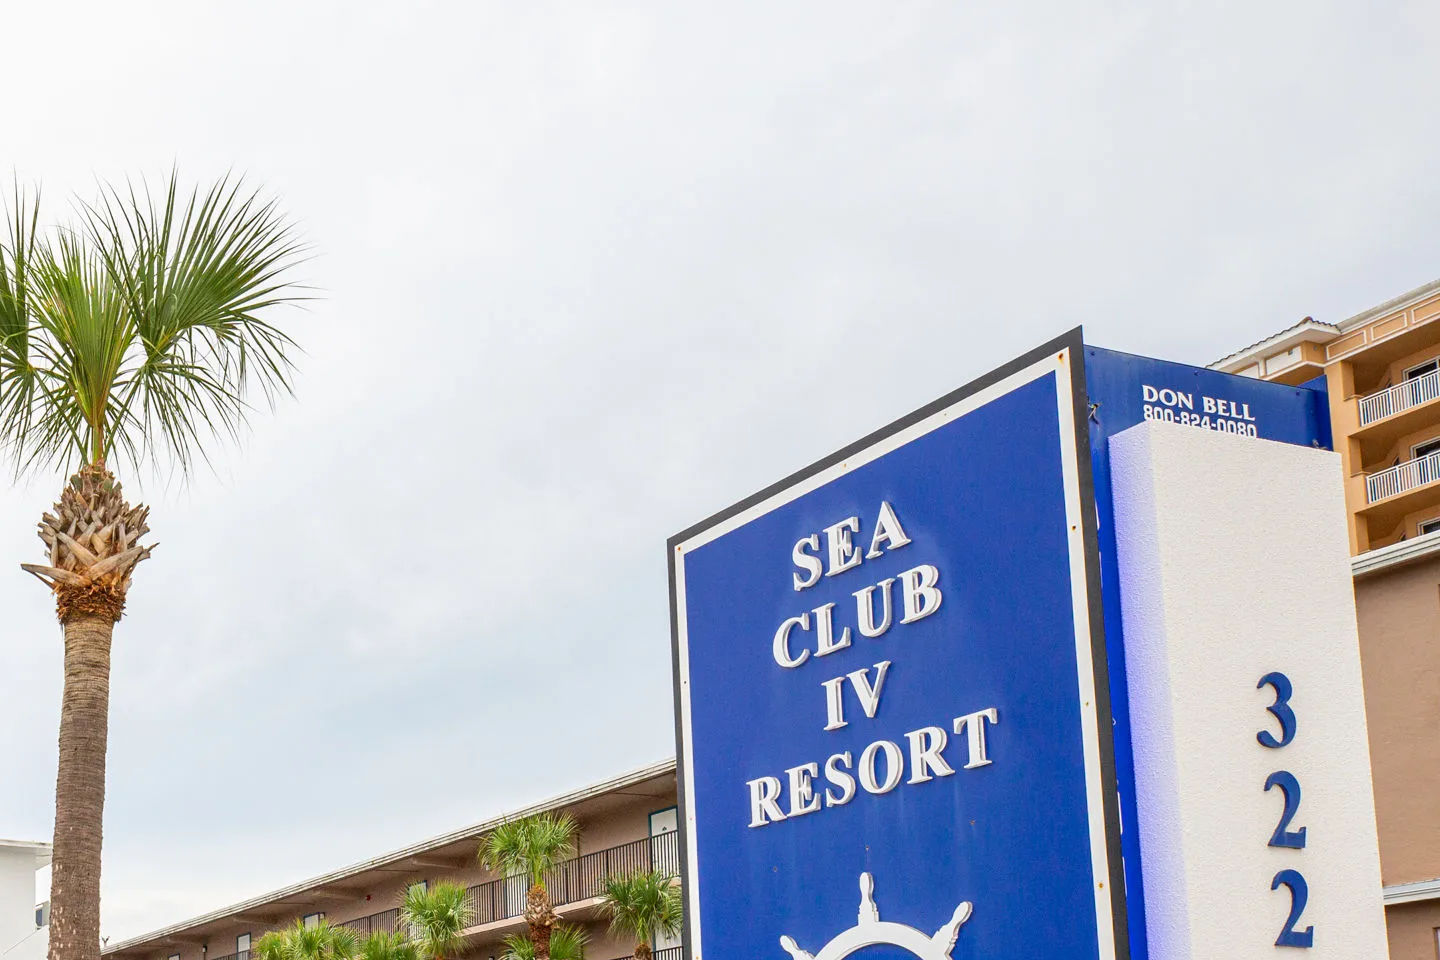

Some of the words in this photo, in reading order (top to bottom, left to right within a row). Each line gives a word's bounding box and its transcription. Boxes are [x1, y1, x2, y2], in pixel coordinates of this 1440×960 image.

[1142, 384, 1194, 410] DON
[1202, 396, 1256, 421] BELL
[1143, 404, 1258, 438] 800-824-0080
[792, 501, 911, 591] SEA
[773, 564, 942, 668] CLUB
[821, 661, 891, 730] IV
[746, 708, 998, 827] RESORT
